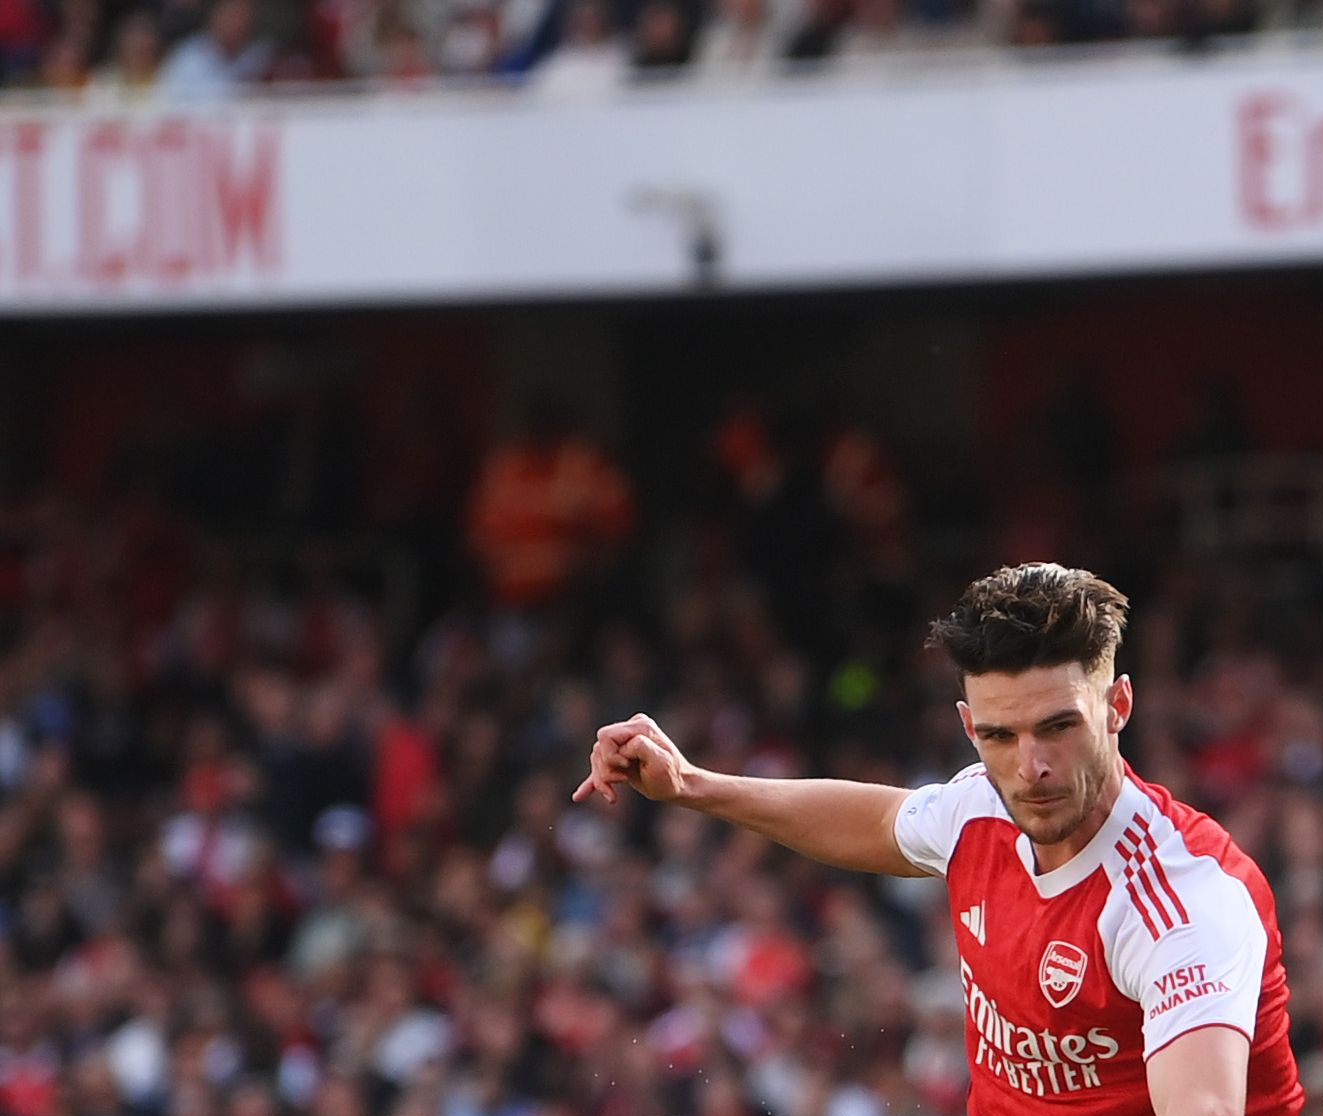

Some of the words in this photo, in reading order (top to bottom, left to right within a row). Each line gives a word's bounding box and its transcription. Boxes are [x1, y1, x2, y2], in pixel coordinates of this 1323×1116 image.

[1154, 964, 1206, 995] VISIT
[961, 955, 1119, 1064] Emirates
[1002, 1056, 1101, 1097] BETTER
